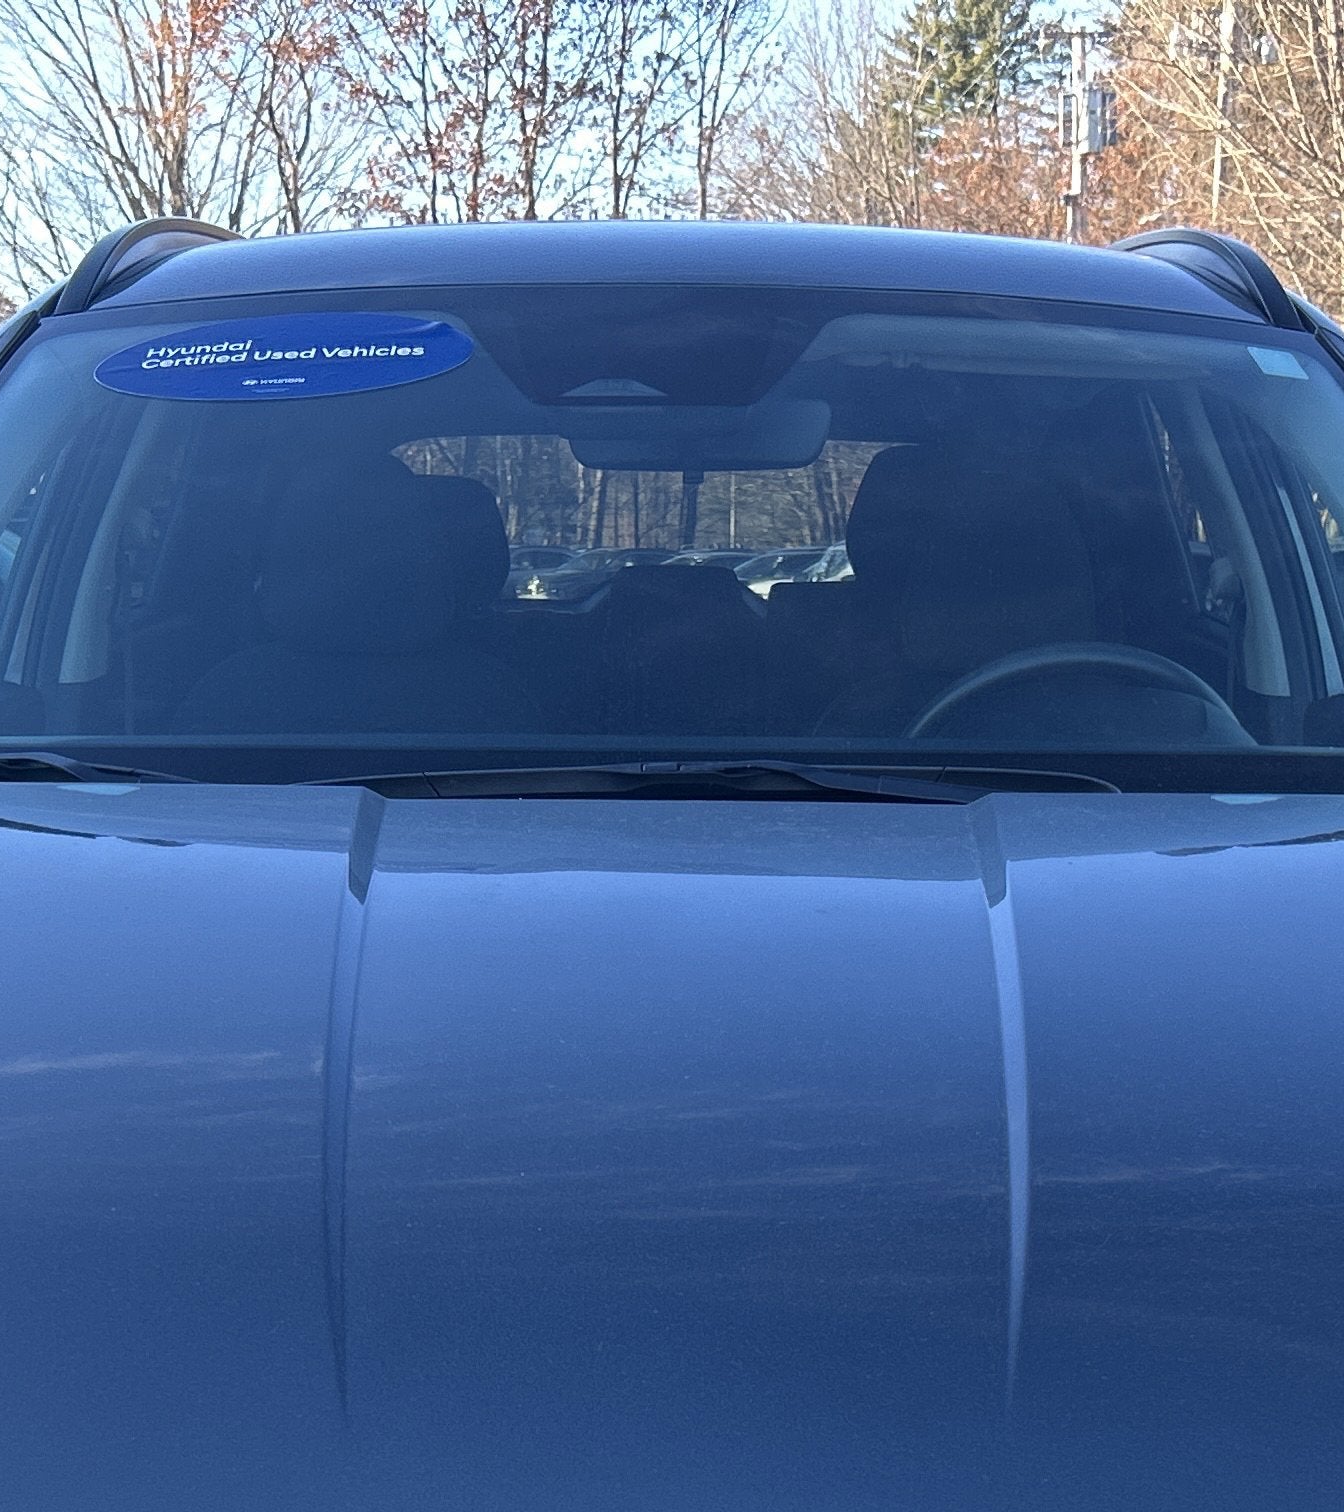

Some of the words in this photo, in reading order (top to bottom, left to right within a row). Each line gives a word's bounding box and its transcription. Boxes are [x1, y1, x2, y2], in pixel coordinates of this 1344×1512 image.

[141, 351, 248, 369] Certified
[253, 347, 317, 361] Used
[322, 345, 425, 358] Vehicles
[146, 340, 253, 358] Hyundai
